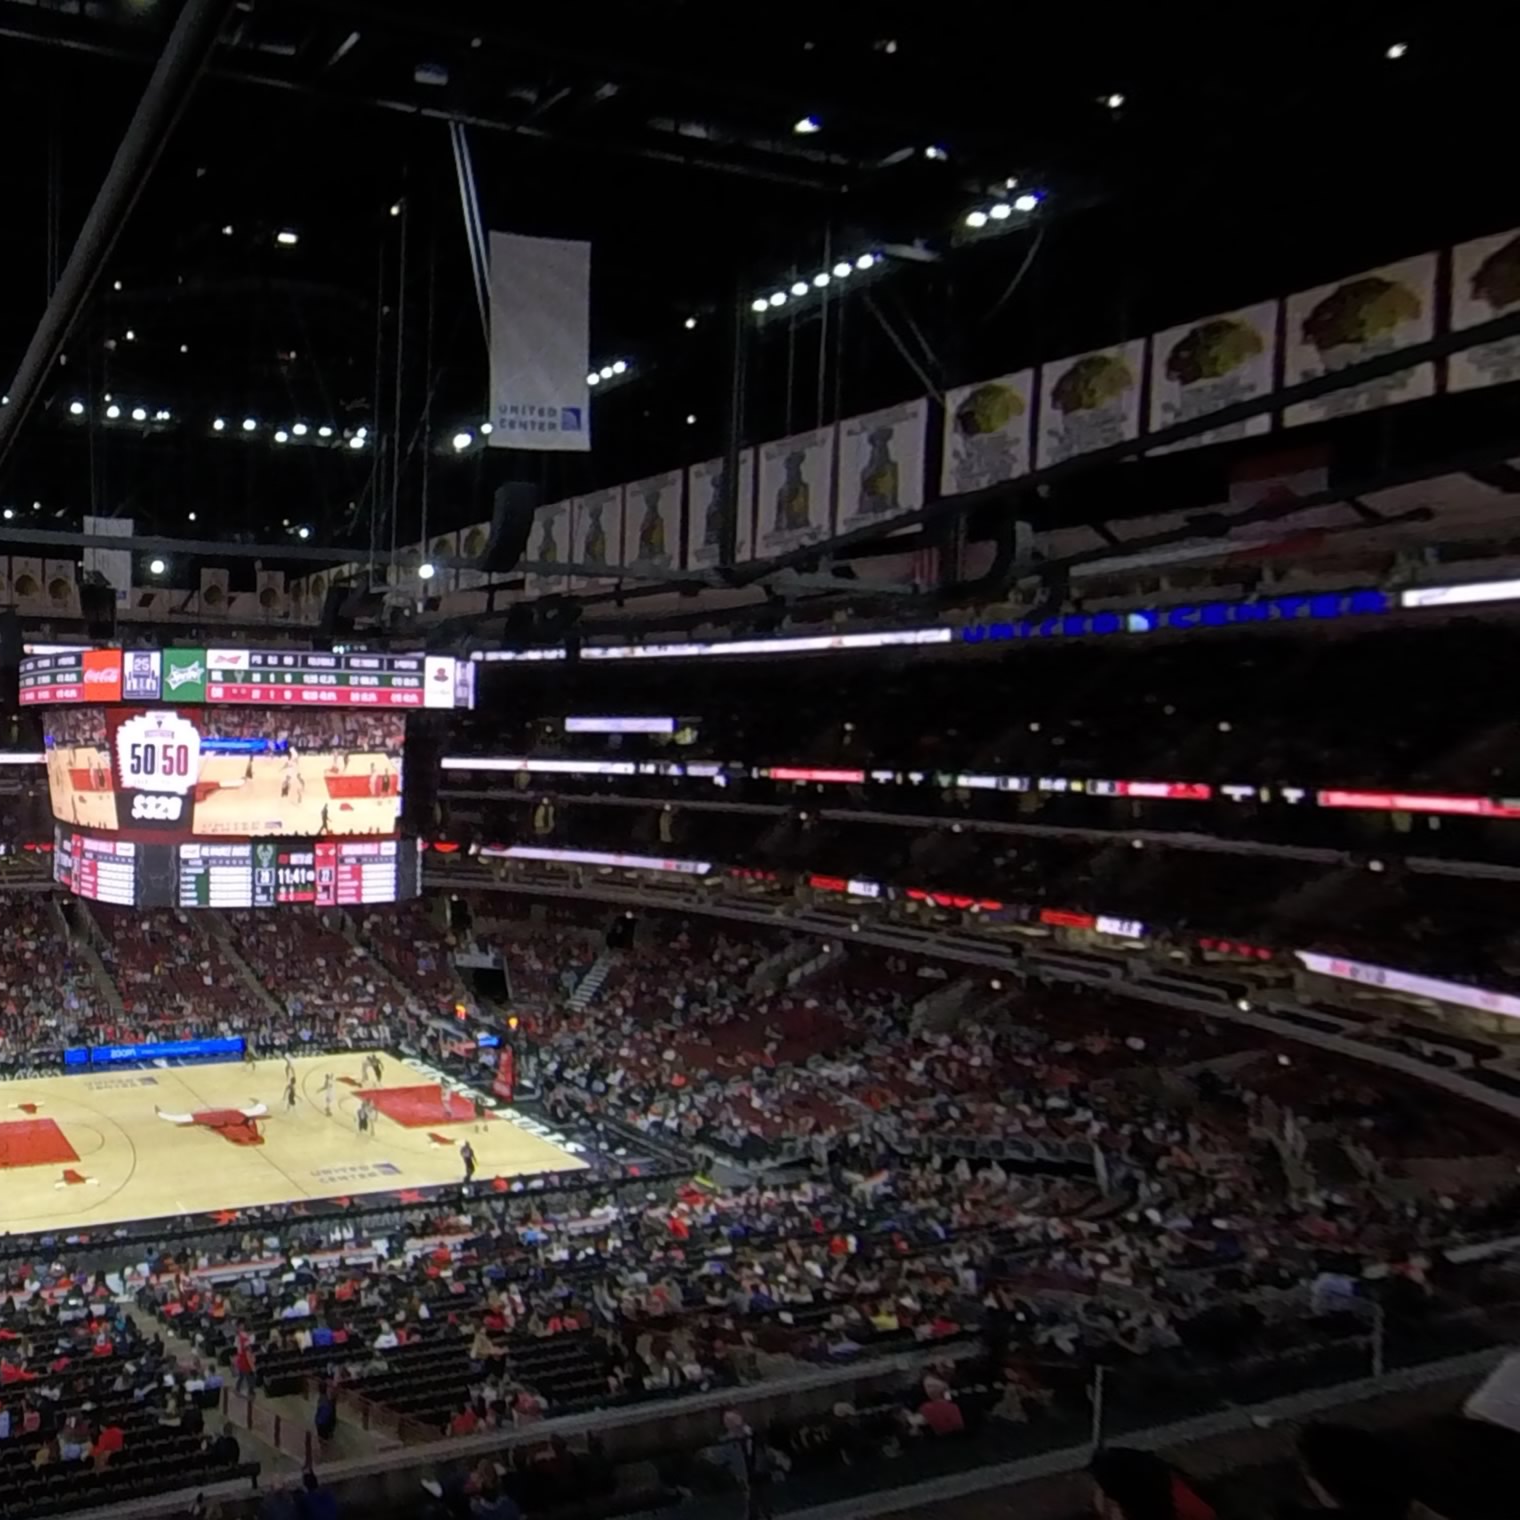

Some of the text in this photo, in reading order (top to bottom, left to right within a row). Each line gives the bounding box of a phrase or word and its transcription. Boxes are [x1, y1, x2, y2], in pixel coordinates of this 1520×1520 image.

[498, 405, 558, 417] UNITED
[499, 418, 557, 432] CENTER
[962, 590, 1388, 644] UNITED CENTER
[134, 657, 149, 671] 25
[131, 743, 189, 776] 50 50
